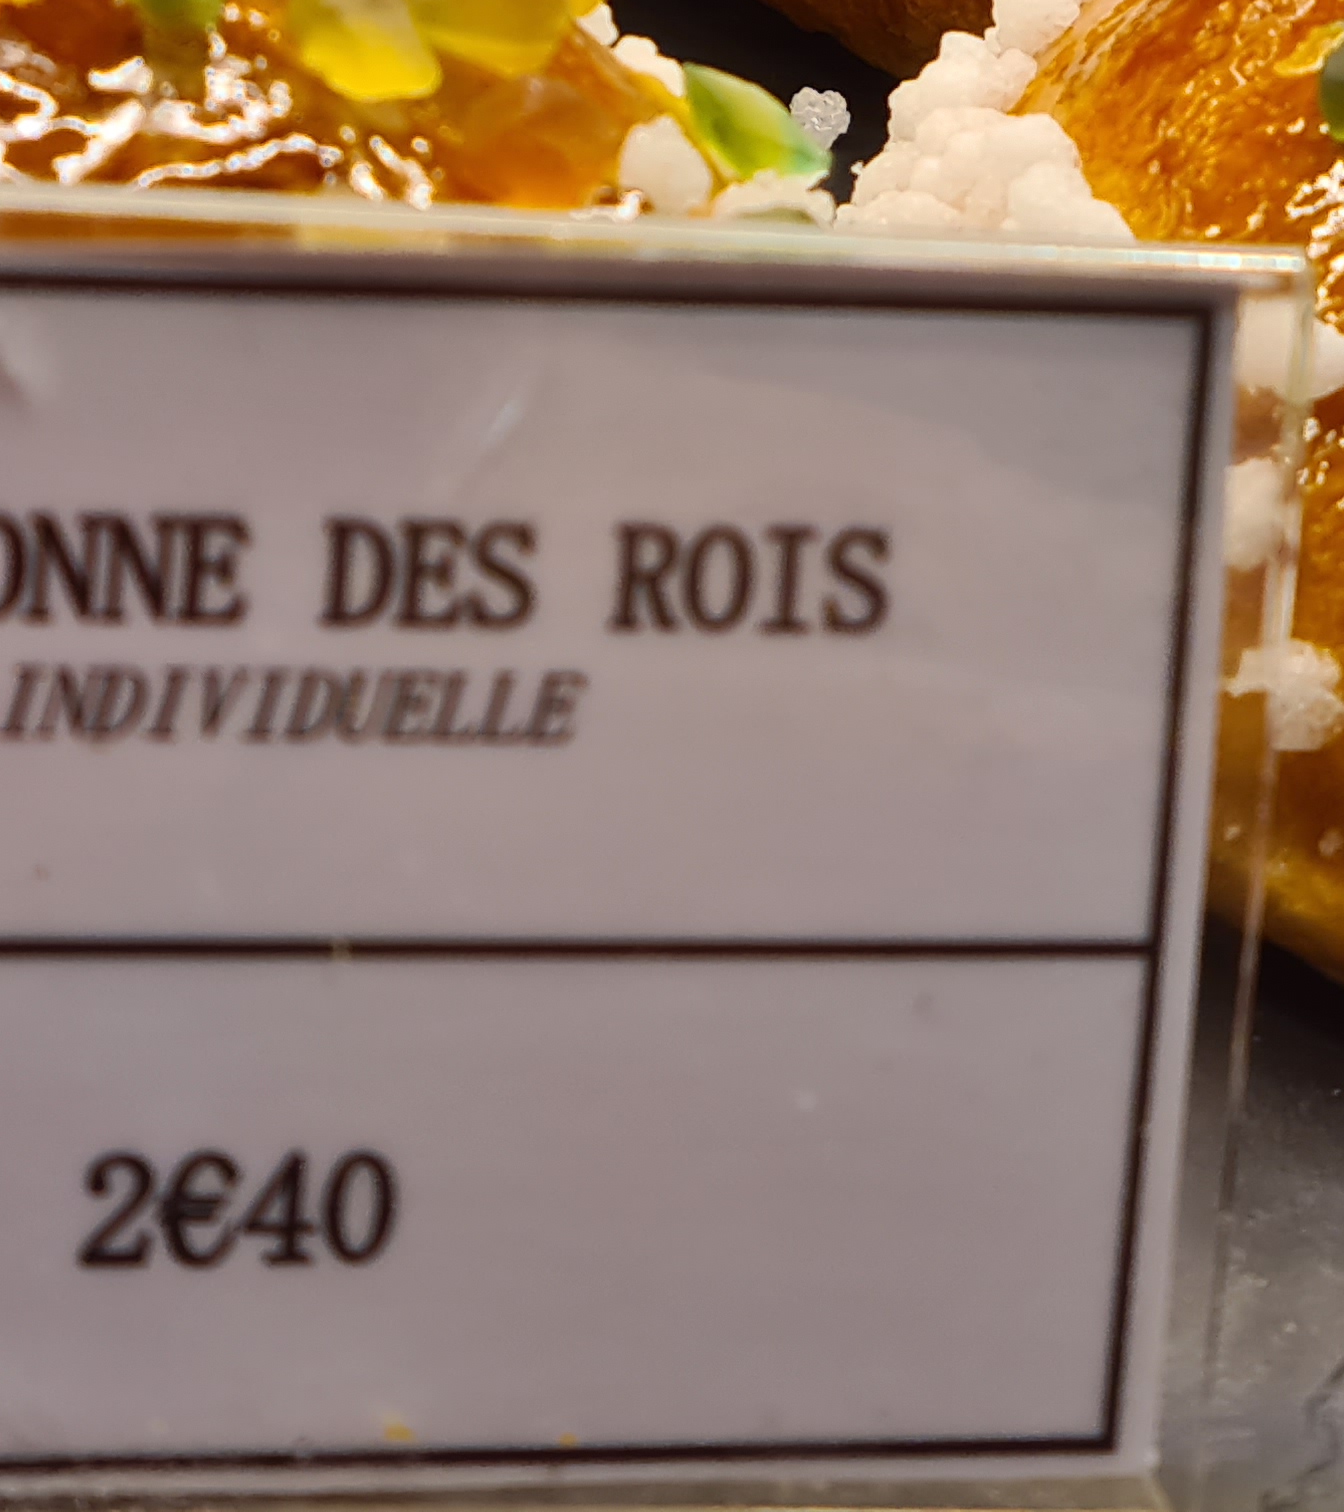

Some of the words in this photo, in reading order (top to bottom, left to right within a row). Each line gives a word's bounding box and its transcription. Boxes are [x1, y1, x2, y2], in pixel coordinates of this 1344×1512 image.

[320, 515, 537, 631] DES
[609, 522, 891, 637] ROIS
[78, 1150, 398, 1269] 2€40
